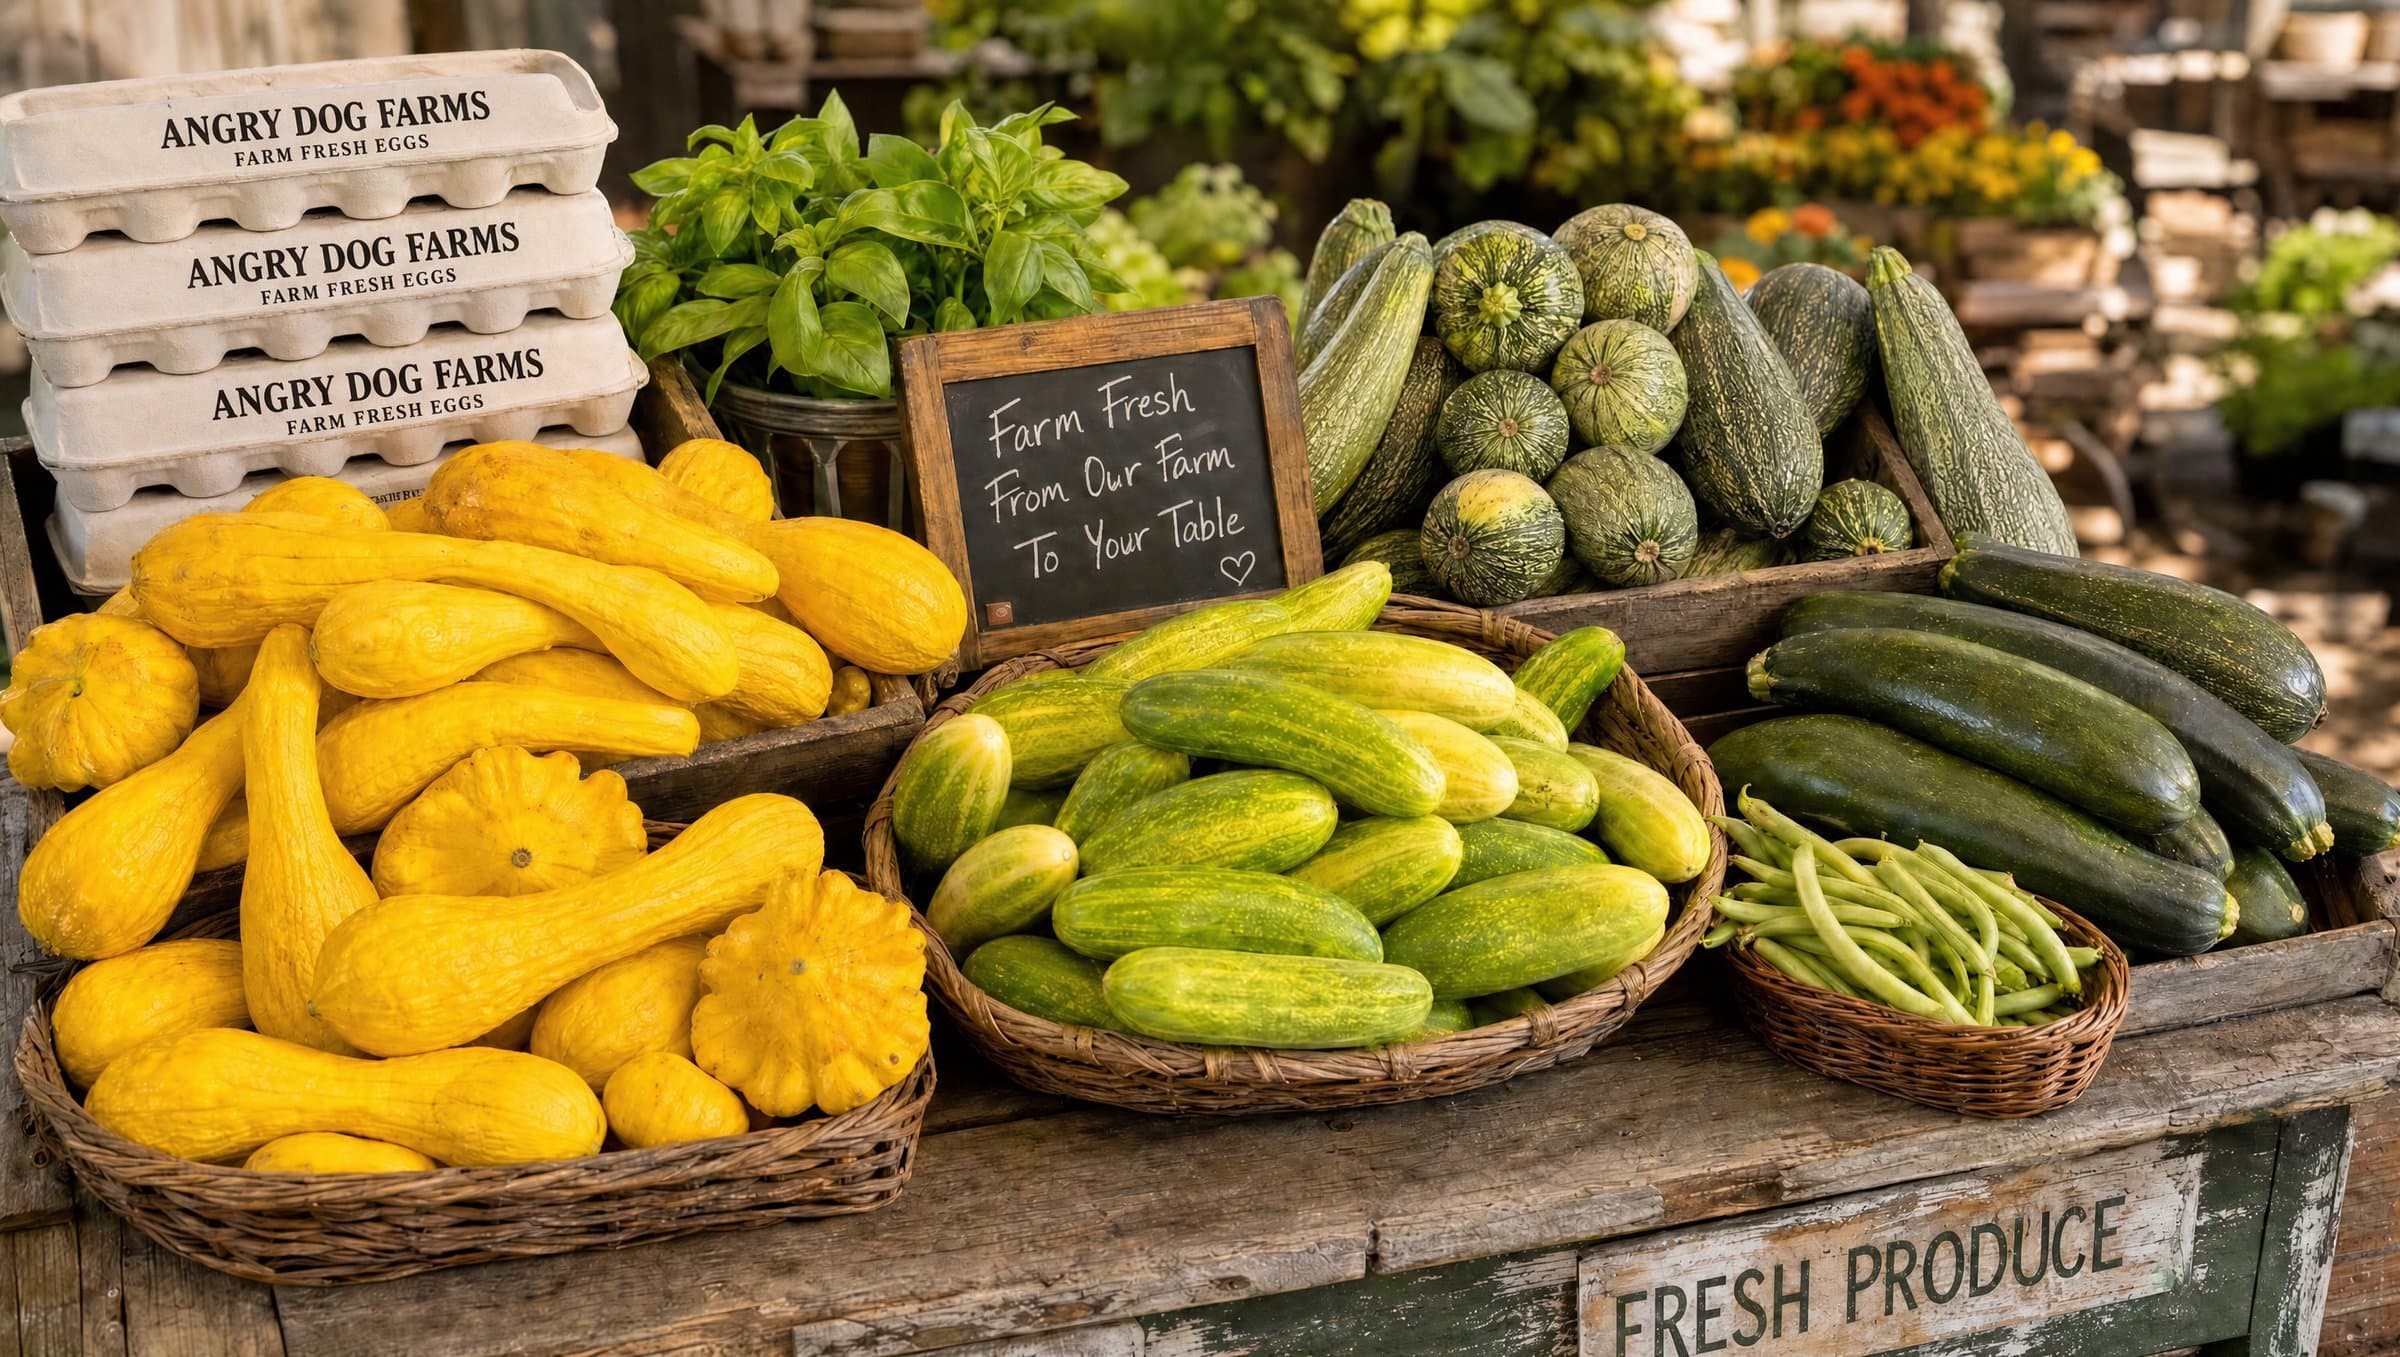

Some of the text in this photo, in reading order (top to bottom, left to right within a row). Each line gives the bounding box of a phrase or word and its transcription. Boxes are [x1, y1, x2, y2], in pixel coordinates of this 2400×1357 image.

[161, 91, 489, 148] ANGRY DOG FARMS
[235, 135, 428, 166] FARM FRESH EGGS
[188, 223, 519, 288] ANGRY DOG FARMS
[261, 268, 456, 305] FARM FRESH EGGS
[212, 349, 543, 420] ANGRY DOG FARMS
[287, 394, 483, 435] FARM FRESH EGGS
[989, 373, 1195, 458] Farm Fresh
[985, 433, 1235, 523] From Our Farm
[1014, 496, 1244, 578] To Your Table
[1615, 1196, 2127, 1357] FRESH PRODUCE
